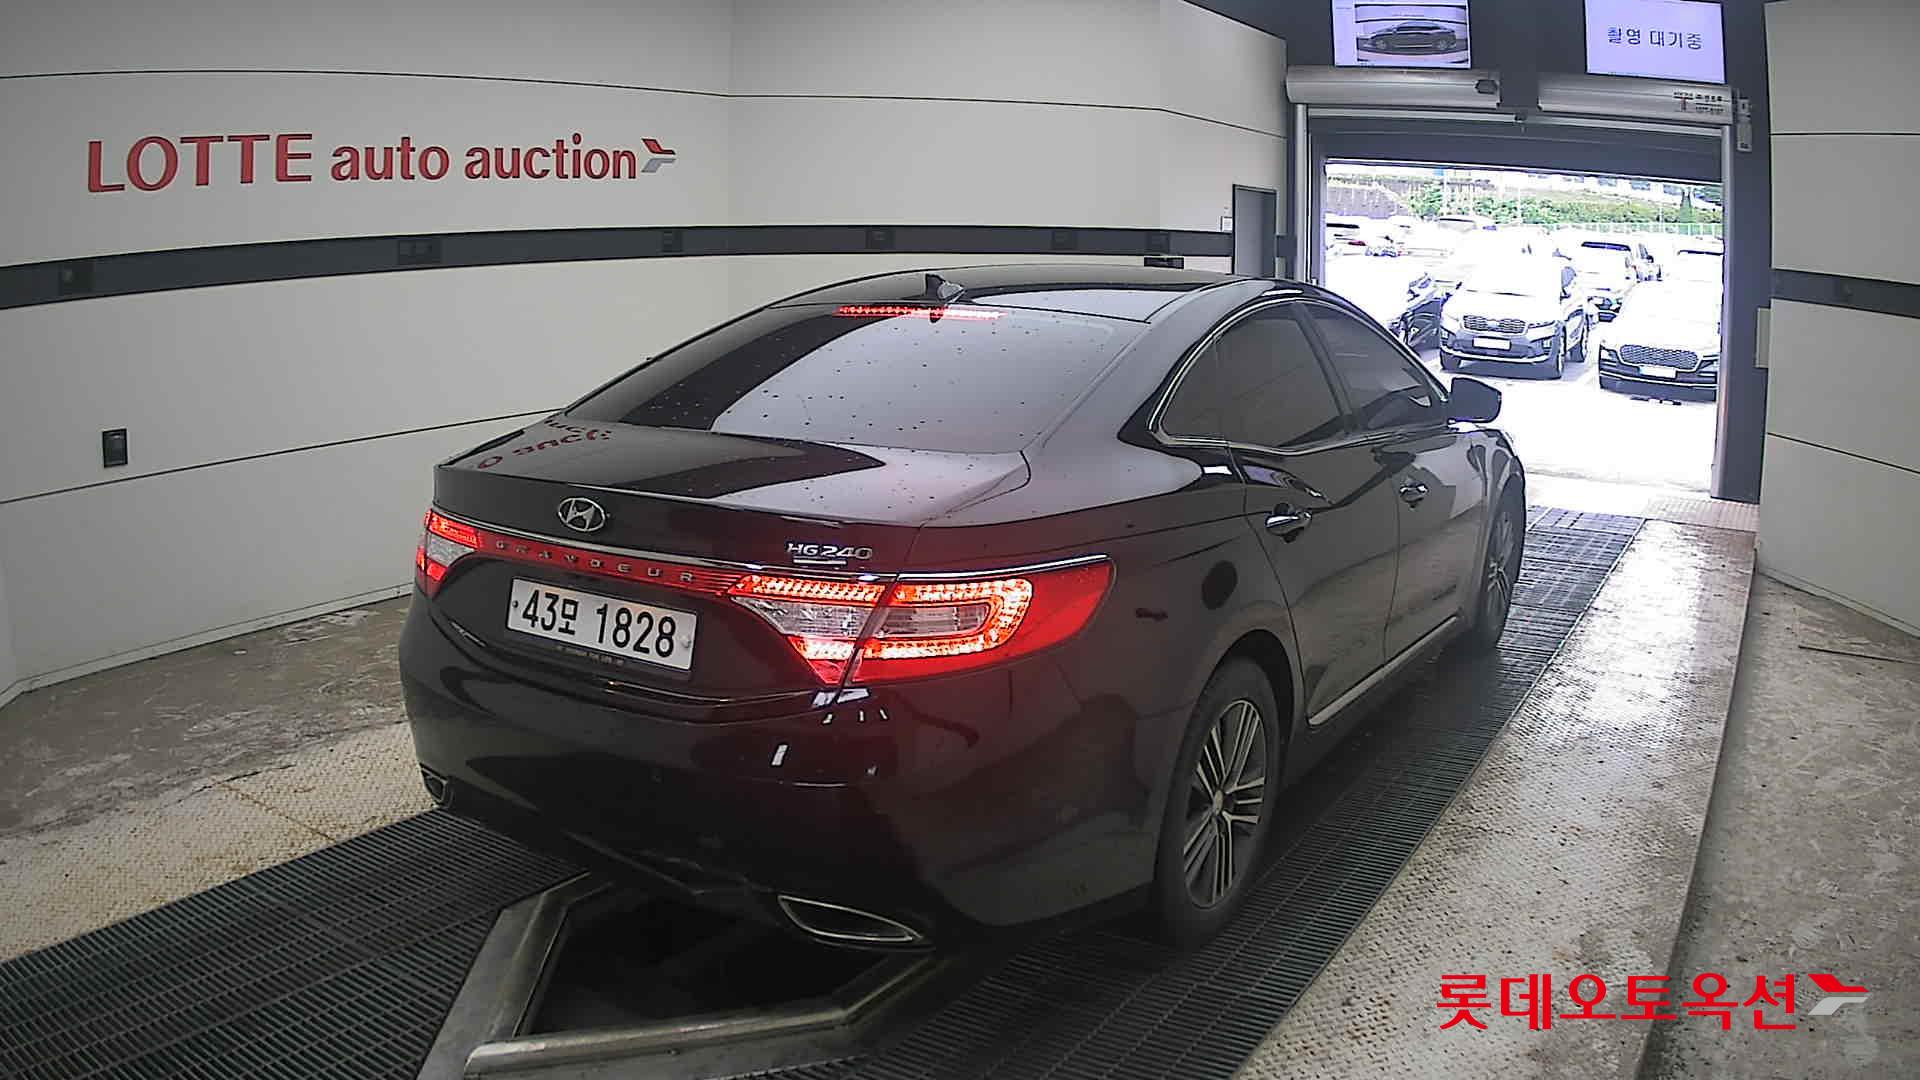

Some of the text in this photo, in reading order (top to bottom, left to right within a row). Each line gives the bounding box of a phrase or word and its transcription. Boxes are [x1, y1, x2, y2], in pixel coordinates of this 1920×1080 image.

[1649, 30, 1702, 50] 대기중
[88, 132, 638, 193] LOTTE auto auction
[786, 542, 873, 560] HG240
[522, 588, 580, 636] 43모
[596, 602, 677, 658] 1828
